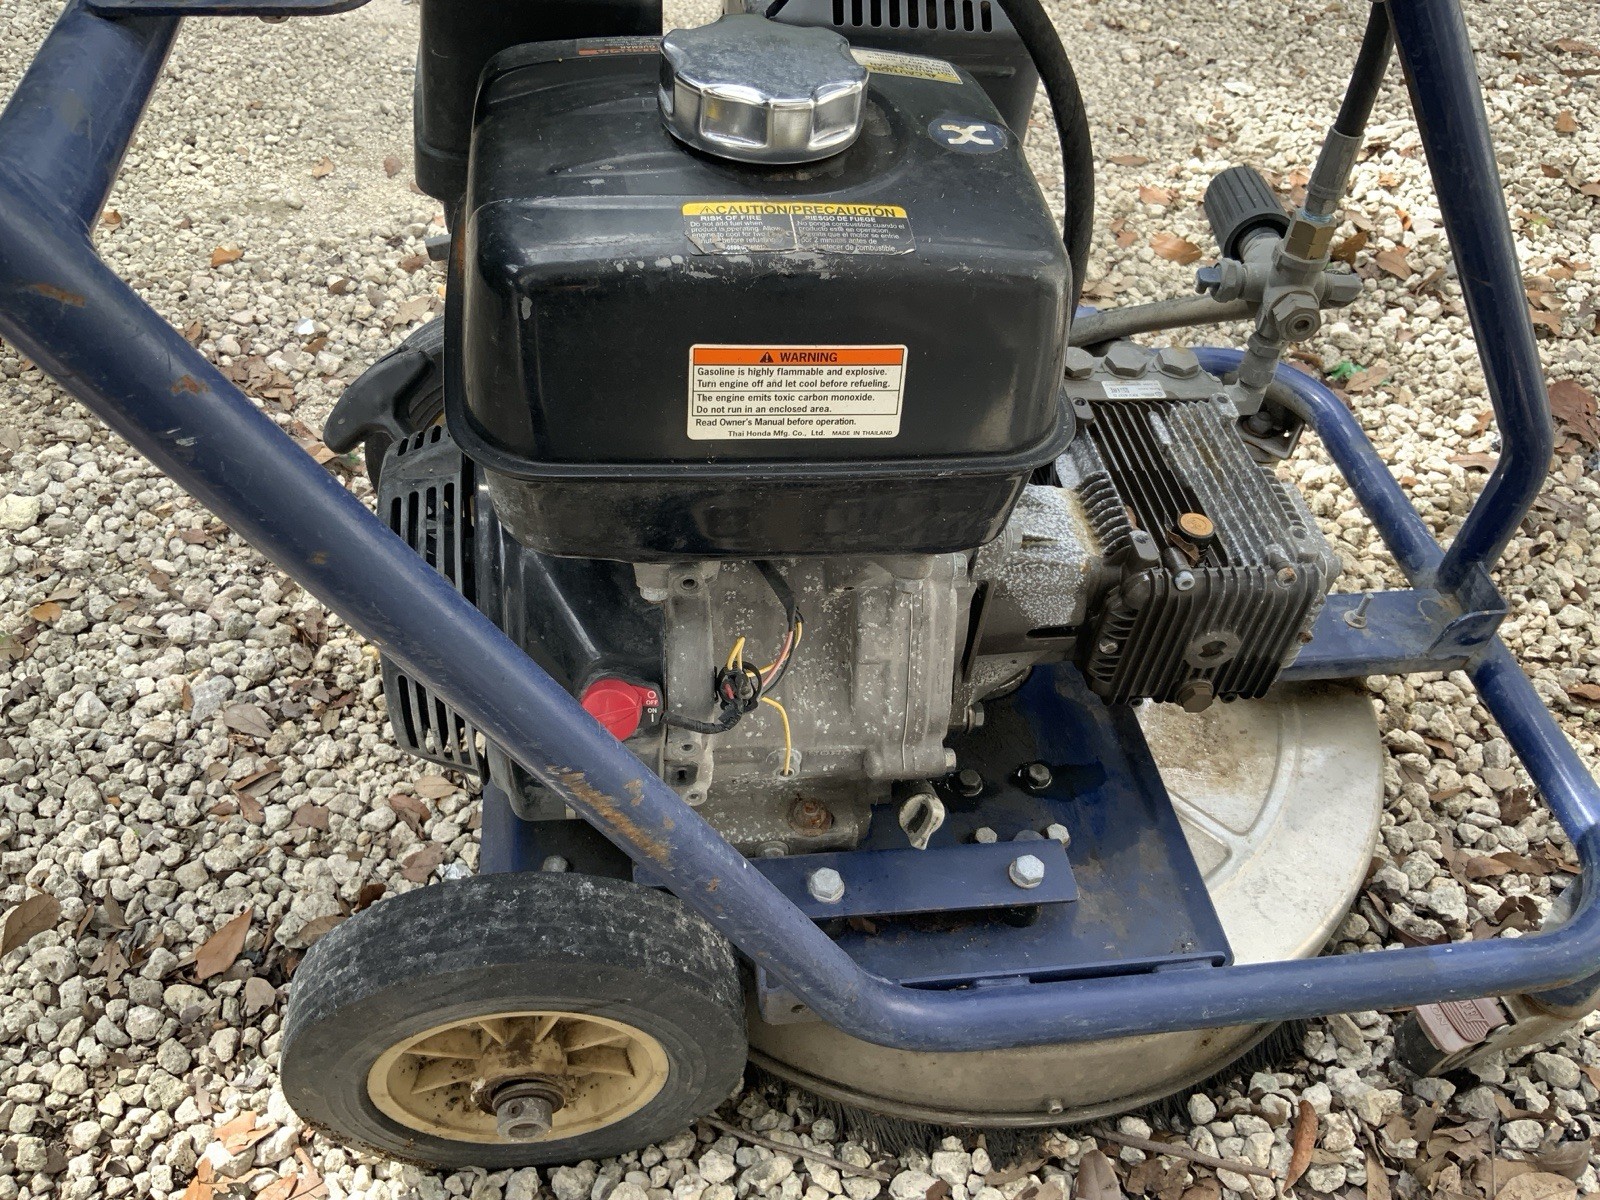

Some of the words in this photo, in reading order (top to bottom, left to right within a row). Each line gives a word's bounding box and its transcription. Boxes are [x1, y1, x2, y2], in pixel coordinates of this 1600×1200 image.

[715, 204, 896, 218] CAUTION/PRECAUCIÓN
[691, 226, 718, 234] product
[809, 221, 830, 229] ponga
[780, 352, 838, 363] WARNING
[697, 367, 735, 376] Gasoline
[737, 367, 745, 376] is
[747, 367, 774, 378] highly
[777, 367, 824, 376] flammable
[826, 367, 843, 376] and
[845, 367, 887, 378] explosive.
[697, 379, 717, 388] Turn
[719, 379, 749, 390] engine
[751, 379, 764, 388] off
[766, 379, 783, 388] and
[785, 379, 797, 388] let
[799, 379, 818, 388] cool
[820, 379, 848, 388] before
[850, 379, 890, 389] refueling.
[697, 393, 713, 402] The
[715, 393, 745, 403] engine
[747, 393, 772, 402] emits
[774, 393, 796, 402] toxic
[798, 393, 829, 402] carbon
[831, 392, 875, 401] monoxide.
[696, 405, 708, 414] Do
[710, 405, 725, 414] not
[727, 406, 742, 414] run
[744, 404, 753, 413] in
[768, 404, 808, 413] enclosed
[810, 405, 832, 413] area.
[695, 418, 717, 427] Read
[719, 417, 752, 427] Owner's
[754, 417, 785, 426] Manual
[787, 416, 814, 426] before
[815, 416, 857, 427] operation.
[773, 429, 790, 438] Mfg.
